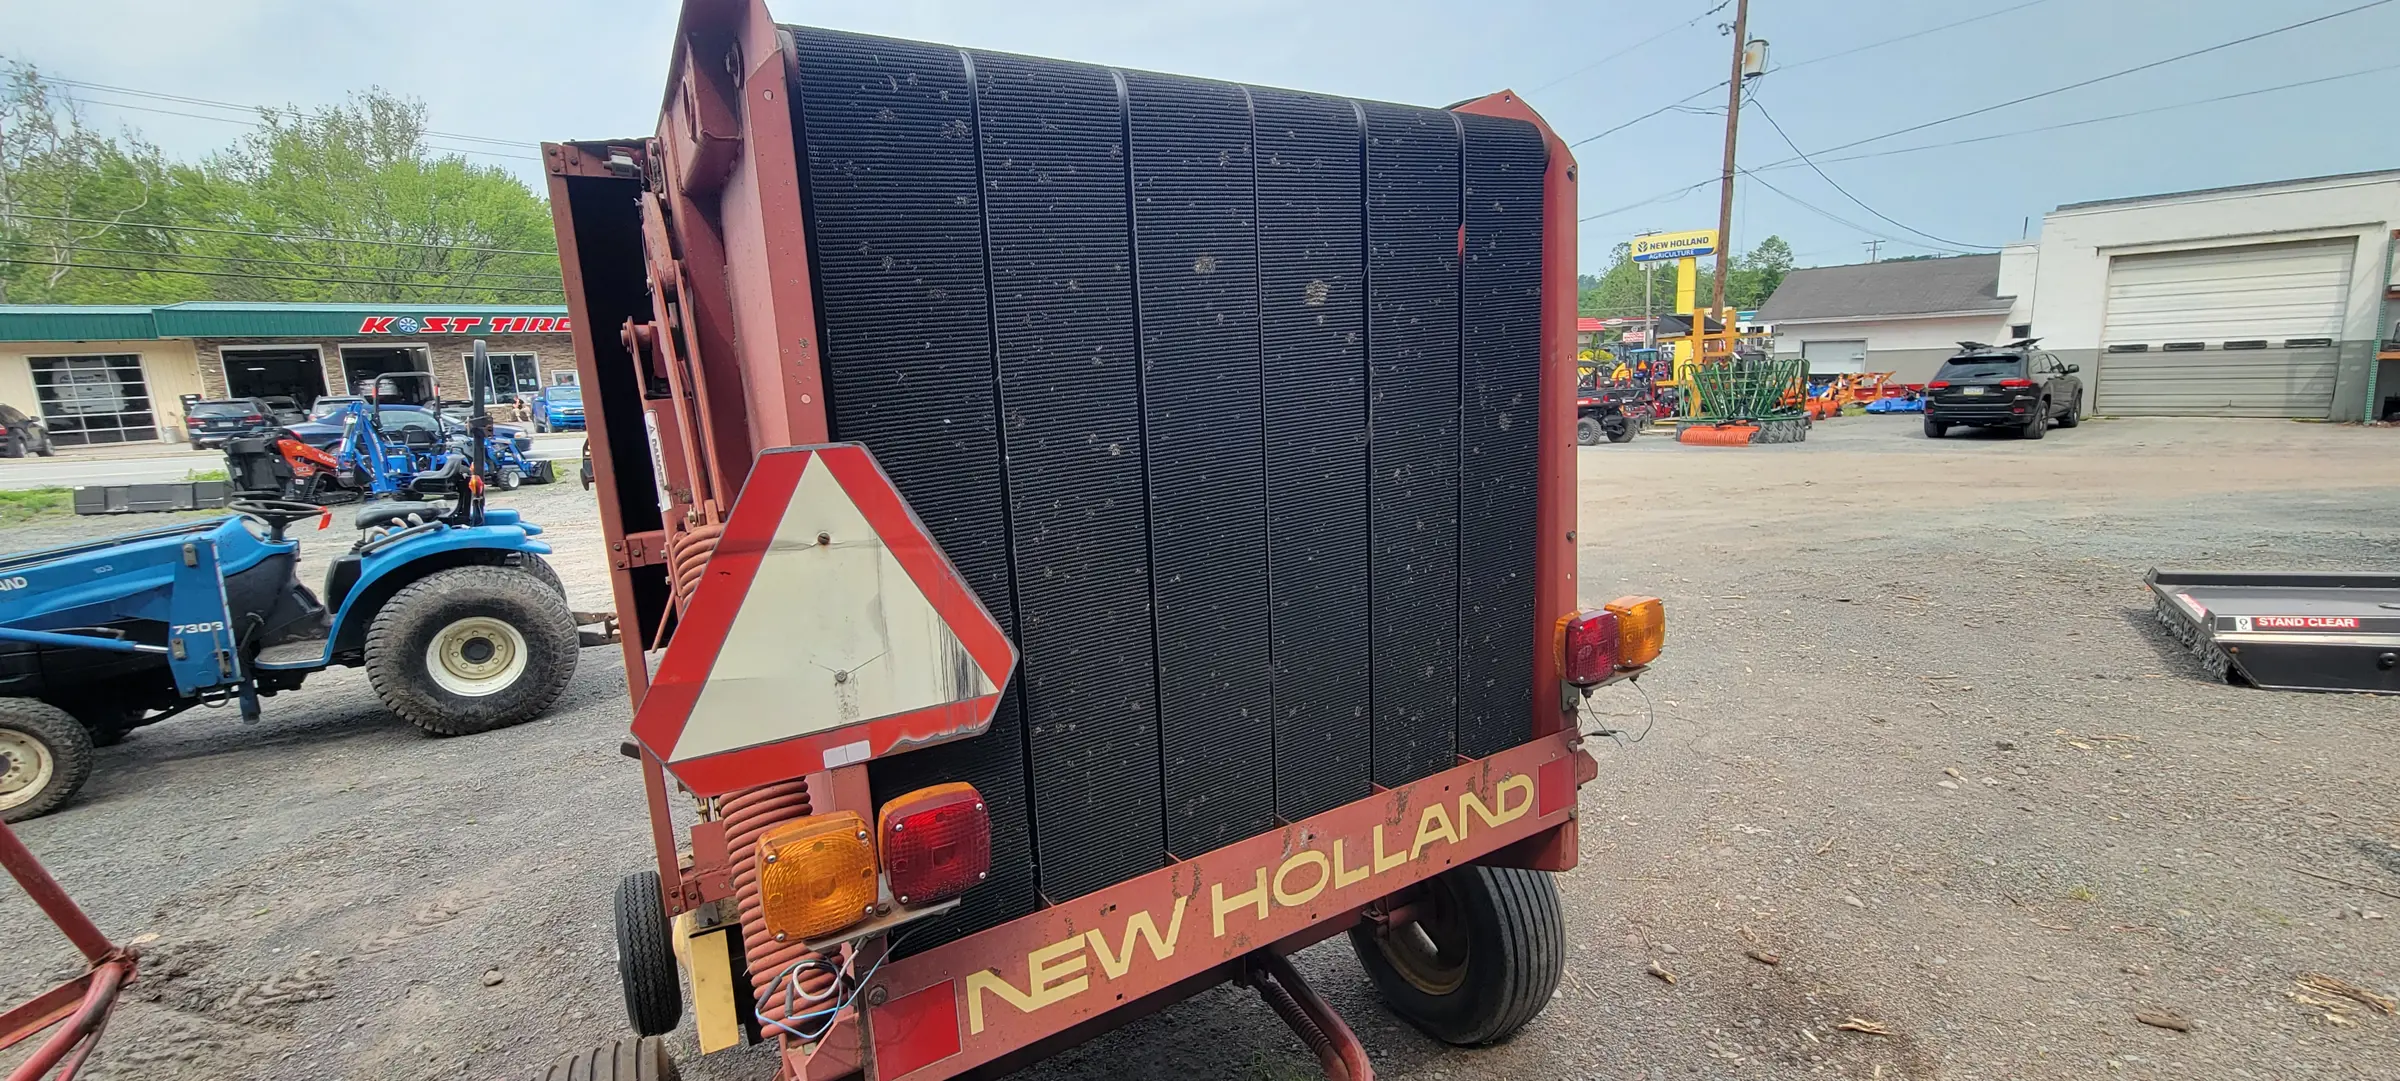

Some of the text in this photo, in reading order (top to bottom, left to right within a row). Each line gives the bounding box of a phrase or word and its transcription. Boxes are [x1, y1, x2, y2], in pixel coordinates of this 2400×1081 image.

[1649, 236, 1709, 250] NEW HOLLAND
[1648, 249, 1694, 260] AGRICULTURE
[172, 621, 224, 635] 7303
[2258, 617, 2354, 628] STAND CLEAR
[966, 774, 1535, 1035] NEW HOLLAND
